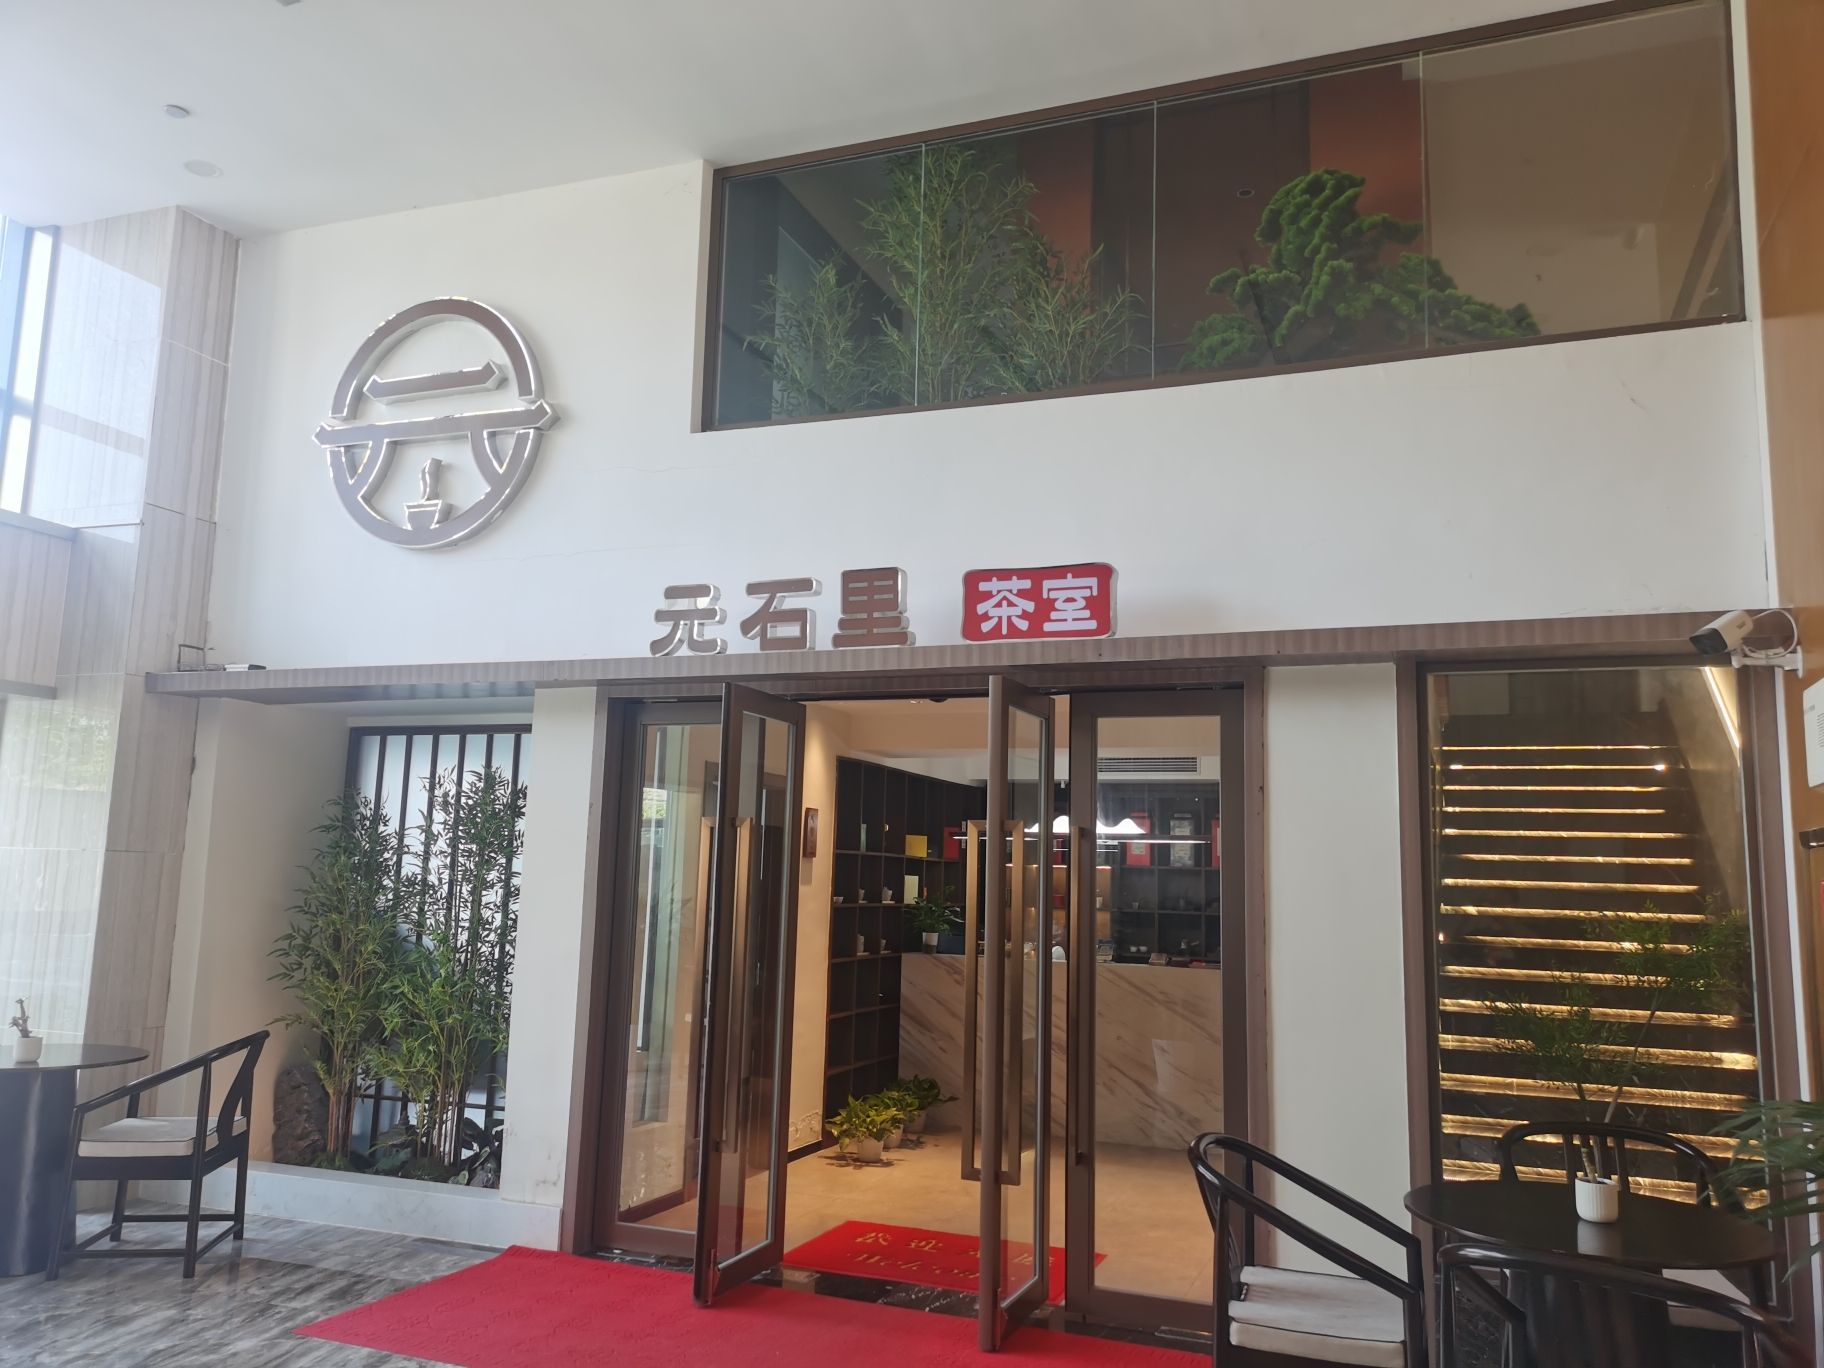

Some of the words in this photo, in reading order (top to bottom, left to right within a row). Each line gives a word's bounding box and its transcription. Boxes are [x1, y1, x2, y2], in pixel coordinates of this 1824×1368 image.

[649, 566, 916, 657] 元石里
[976, 573, 1098, 635] 茶室
